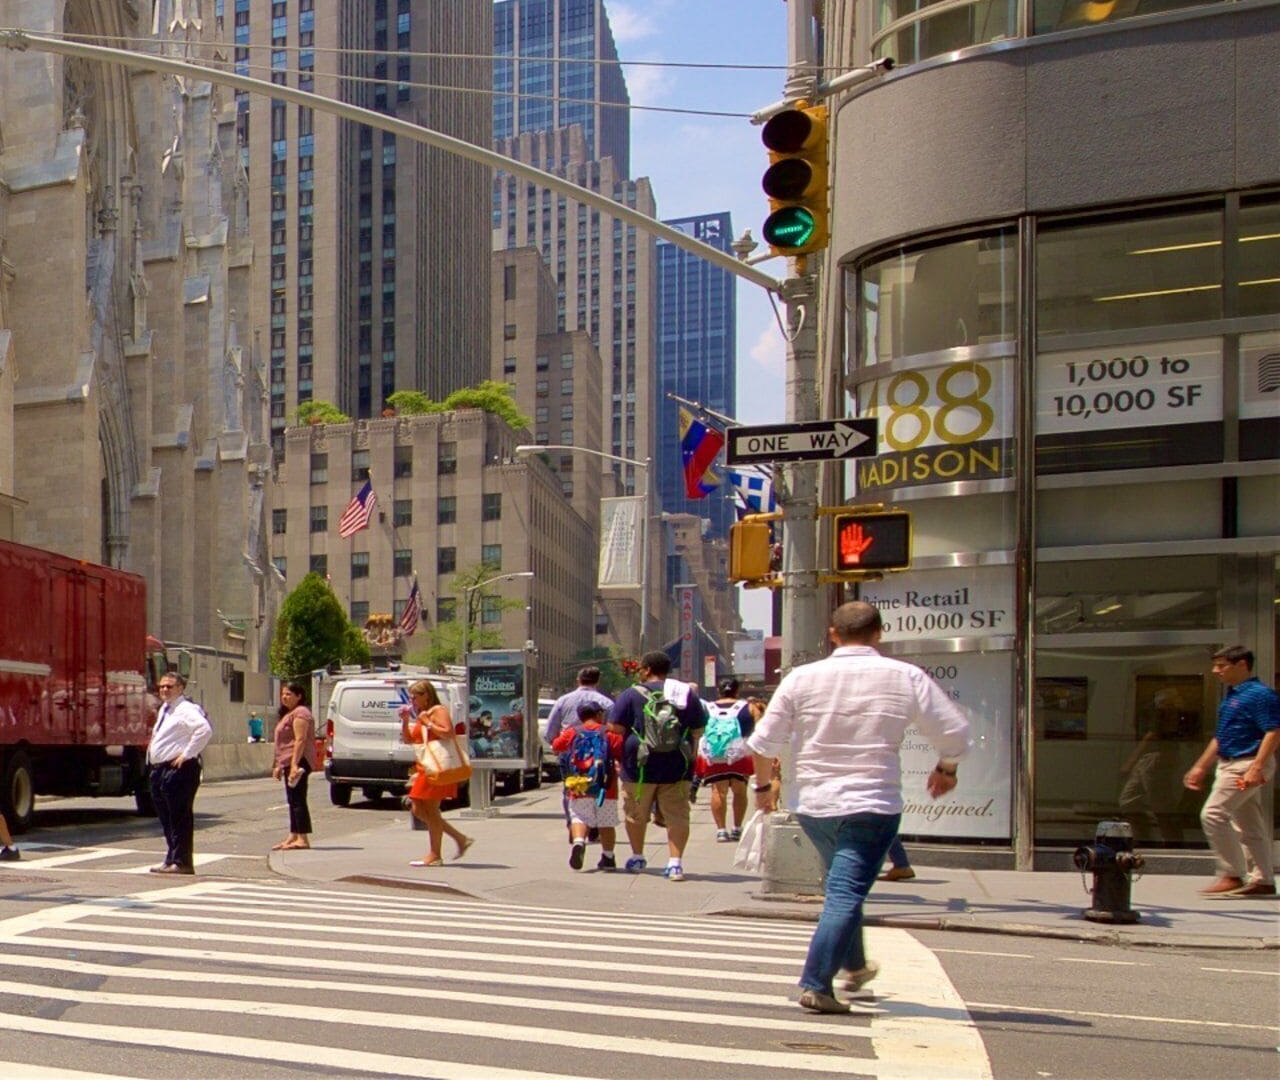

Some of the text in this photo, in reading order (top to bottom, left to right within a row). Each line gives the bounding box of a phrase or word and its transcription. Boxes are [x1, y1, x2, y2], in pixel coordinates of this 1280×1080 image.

[1066, 355, 1190, 387] 1,000 to
[1054, 385, 1202, 419] 10,000 SF
[748, 431, 855, 452] ONE WAY
[905, 587, 971, 609] Retail
[683, 591, 693, 640] RADIO
[897, 612, 964, 634] 10,000
[970, 610, 1006, 629] SF
[361, 700, 387, 709] LANE
